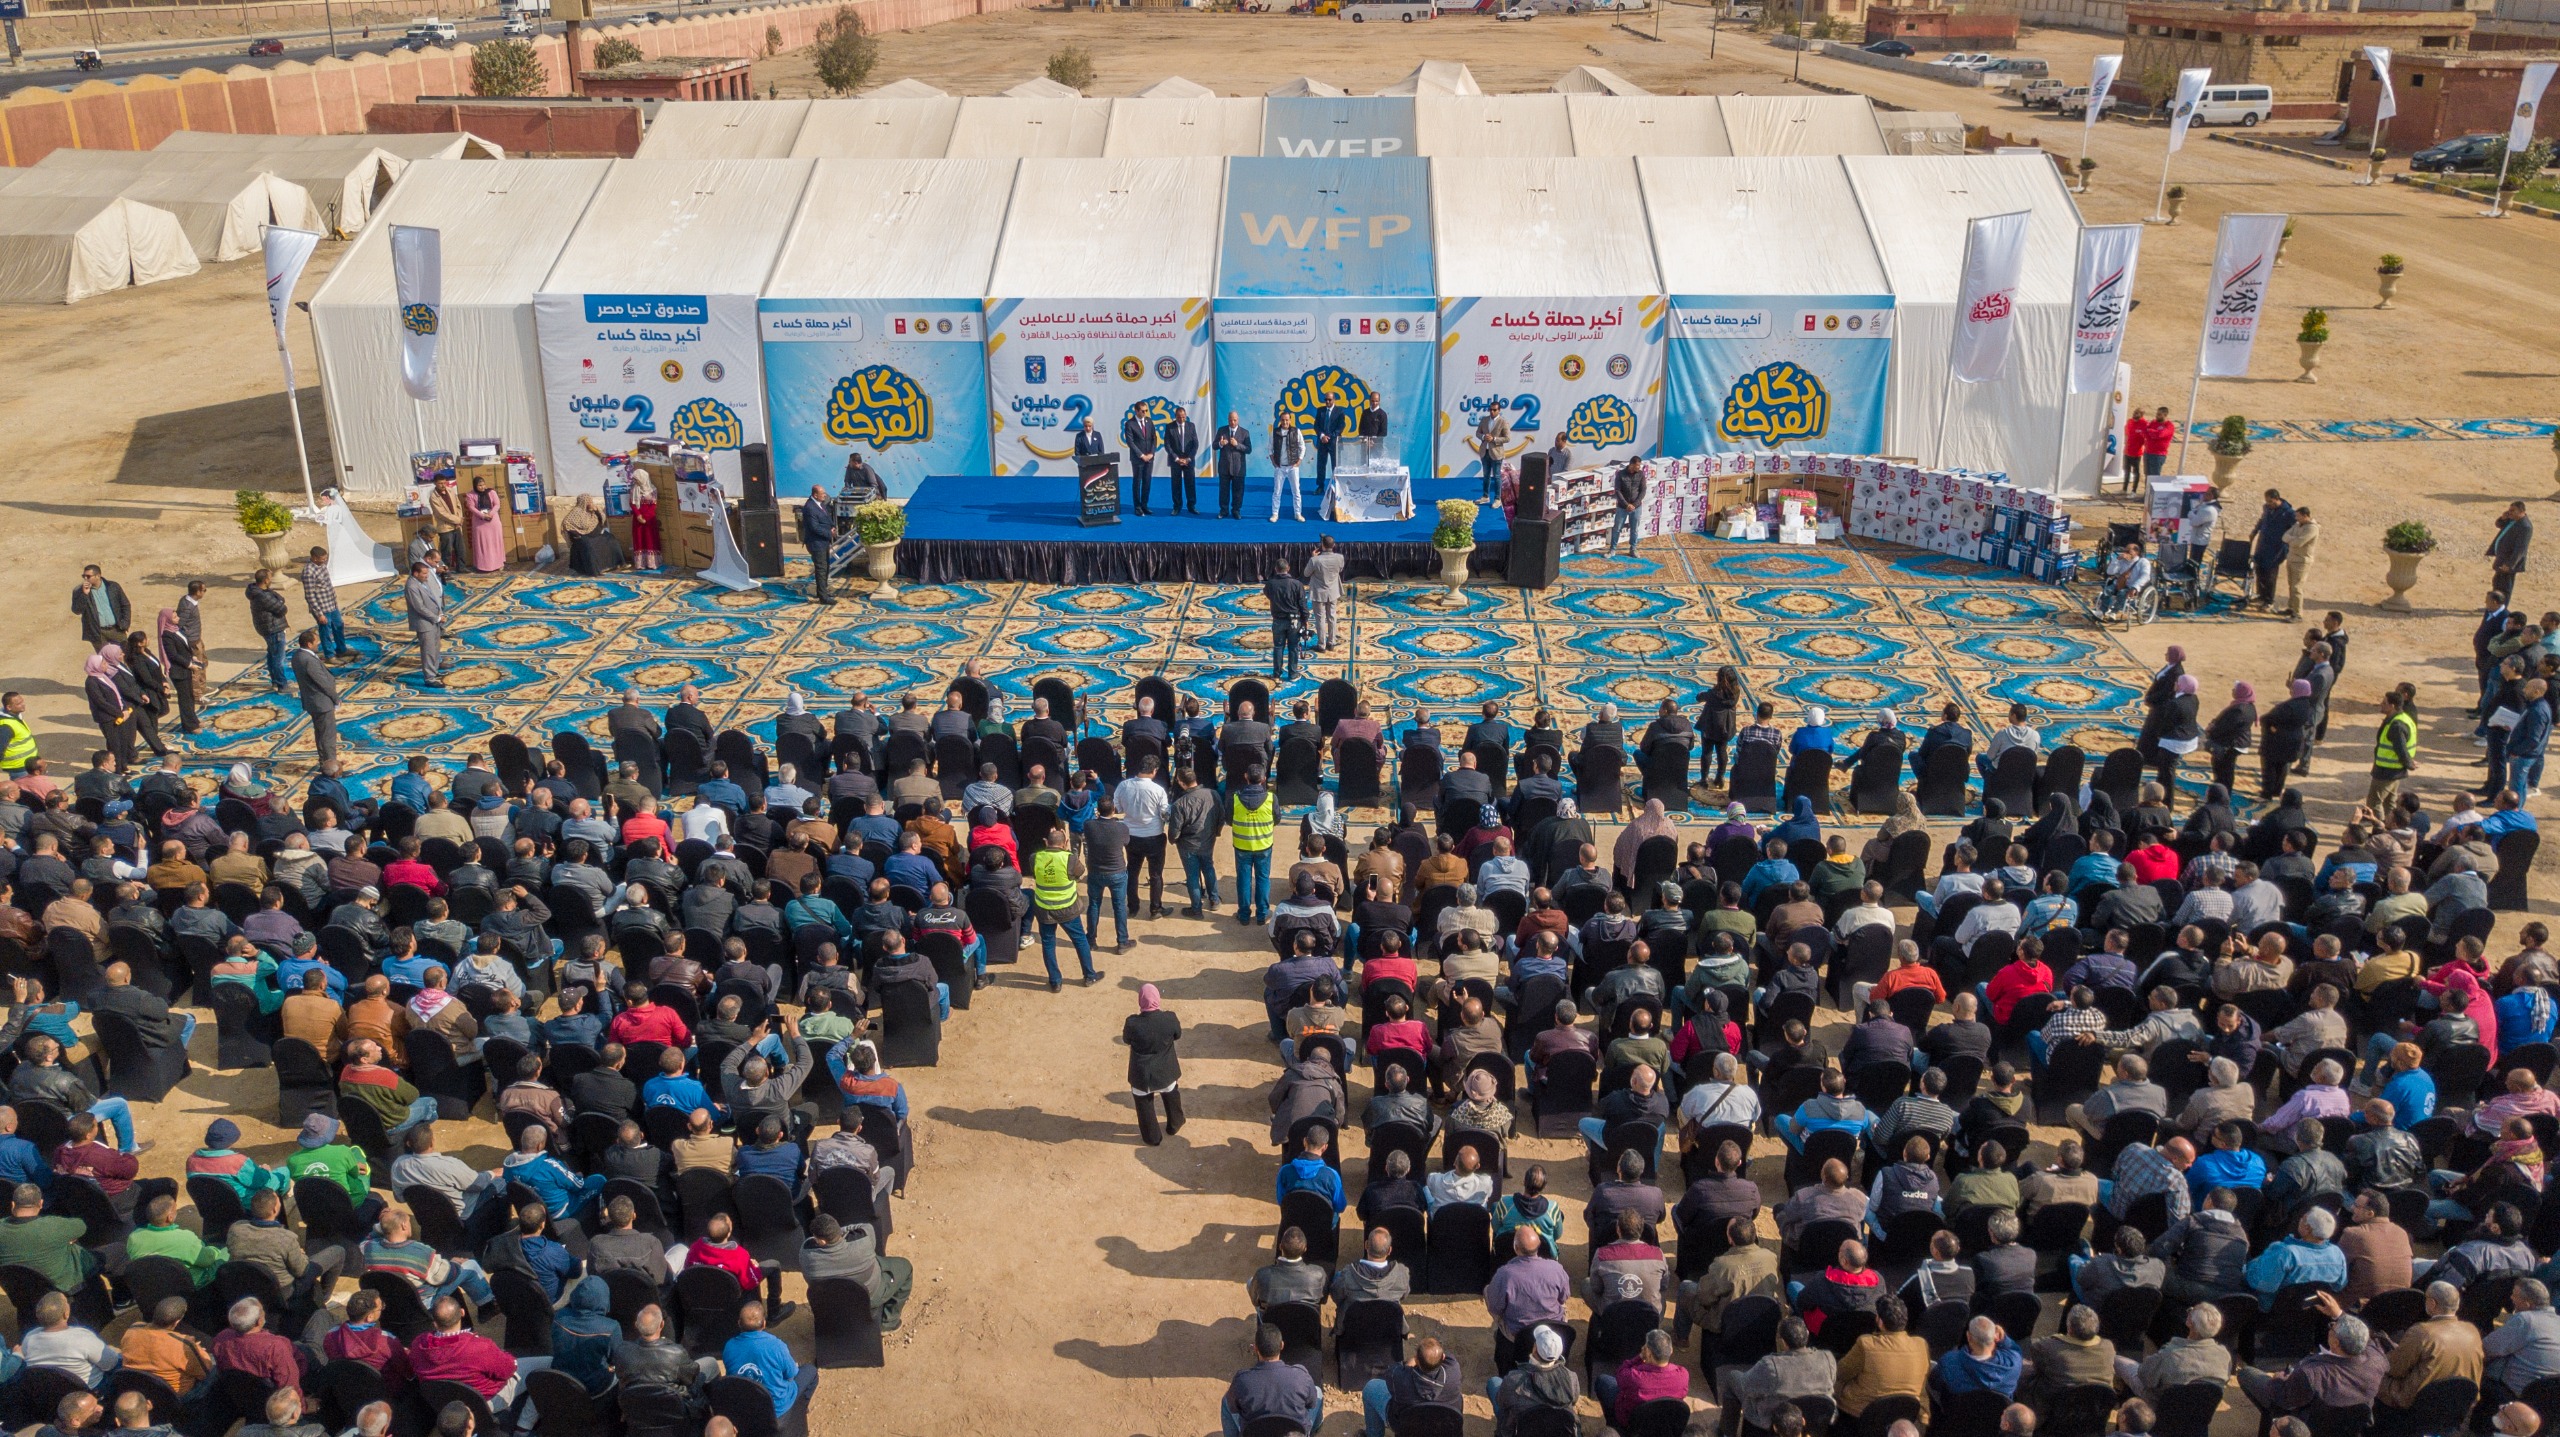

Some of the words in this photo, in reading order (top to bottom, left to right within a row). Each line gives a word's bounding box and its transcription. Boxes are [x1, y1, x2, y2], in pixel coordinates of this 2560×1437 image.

[1278, 137, 1403, 157] WFP
[1240, 212, 1412, 250] WFP
[597, 304, 624, 317] مصر
[627, 303, 651, 318] تحيا
[654, 303, 700, 318] صندوق
[773, 319, 802, 329] كساء
[805, 319, 830, 329] حملة
[832, 316, 852, 331] أكبر
[1019, 313, 1075, 326] للعاملين
[1078, 313, 1113, 324] كساء
[1116, 313, 1148, 324] حملة
[1150, 310, 1176, 326] أكبر
[1220, 319, 1253, 327] للعاملين
[1292, 317, 1308, 327] أكبر
[1491, 311, 1540, 327] كساء
[1544, 312, 1585, 326] حملة
[1589, 306, 1623, 330] أكبر
[1682, 315, 1711, 325] كساء
[1714, 315, 1739, 325] حملة
[1741, 313, 1761, 327] أكبر
[2213, 316, 2253, 326] 037037
[596, 328, 636, 341] كساء
[639, 329, 672, 342] حملة
[675, 326, 701, 345] أكبر
[1020, 331, 1050, 341] القاهرة
[1052, 331, 1086, 341] وتجميل
[1118, 331, 1144, 339] العامة
[1145, 331, 1176, 341] بالهيئة
[1508, 332, 1544, 341] بالرعاية
[1546, 332, 1577, 342] الأولى
[1578, 332, 1604, 341] للأسر
[2077, 329, 2116, 340] 037037
[569, 394, 620, 413] مليون
[1011, 394, 1062, 413] مليون
[623, 394, 656, 433] 2
[1063, 394, 1093, 432] 2
[1510, 393, 1541, 431] 2
[580, 413, 619, 432] فرحة
[1020, 412, 1059, 430] فرحة
